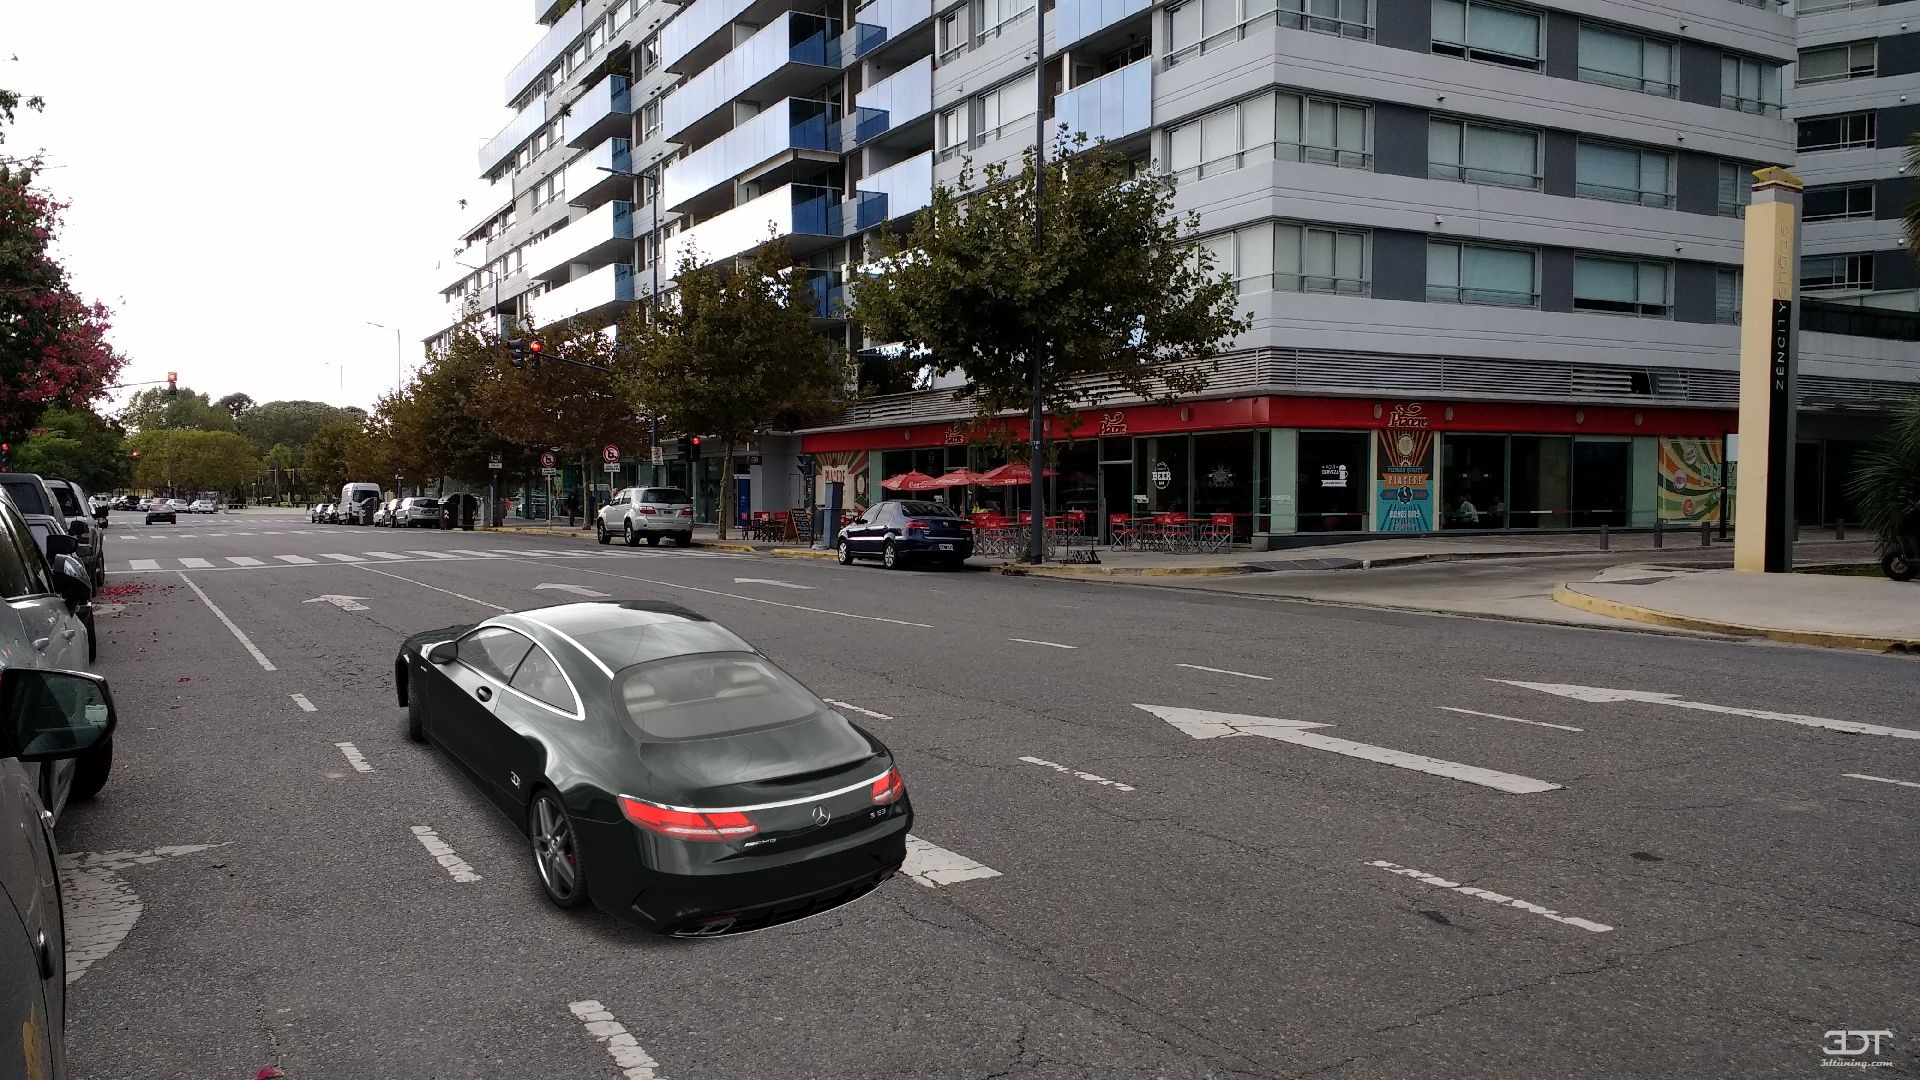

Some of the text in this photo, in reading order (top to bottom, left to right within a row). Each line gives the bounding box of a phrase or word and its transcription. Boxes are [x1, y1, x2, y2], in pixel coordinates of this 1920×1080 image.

[1775, 301, 1787, 390] ZENCITY
[1387, 411, 1429, 428] Piacere
[1151, 471, 1172, 481] BEER
[1388, 475, 1424, 485] PIACERE
